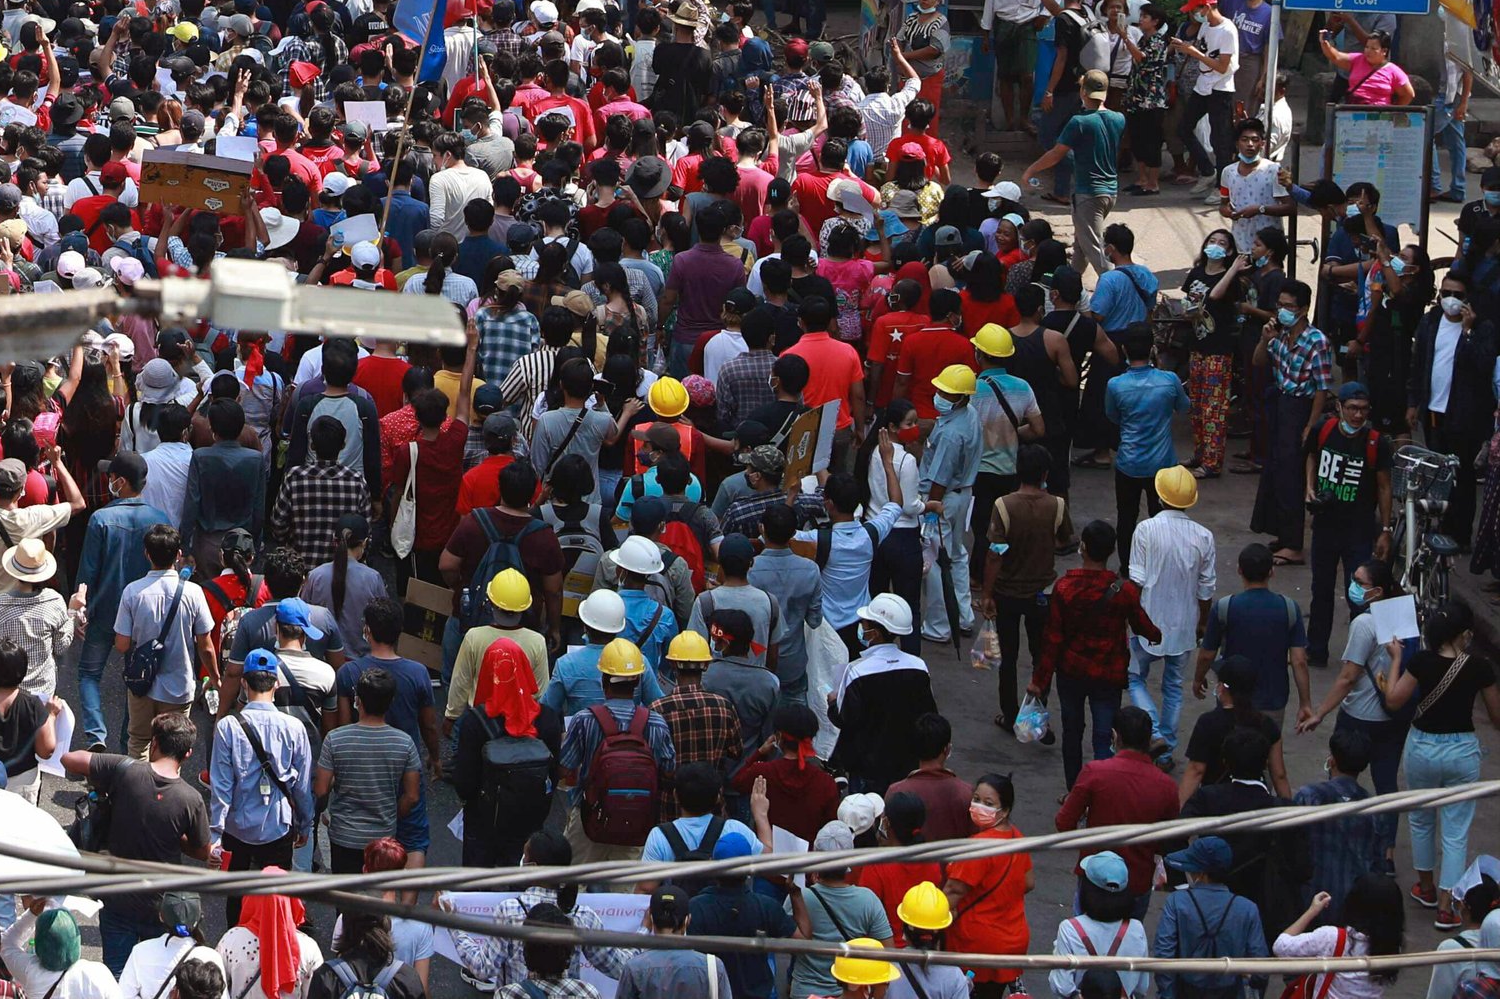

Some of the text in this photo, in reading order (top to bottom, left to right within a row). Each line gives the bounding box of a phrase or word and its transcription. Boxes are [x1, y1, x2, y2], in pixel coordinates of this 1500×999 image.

[1241, 23, 1262, 36] MILE
[1317, 449, 1343, 484] BE
[1341, 460, 1364, 485] THE
